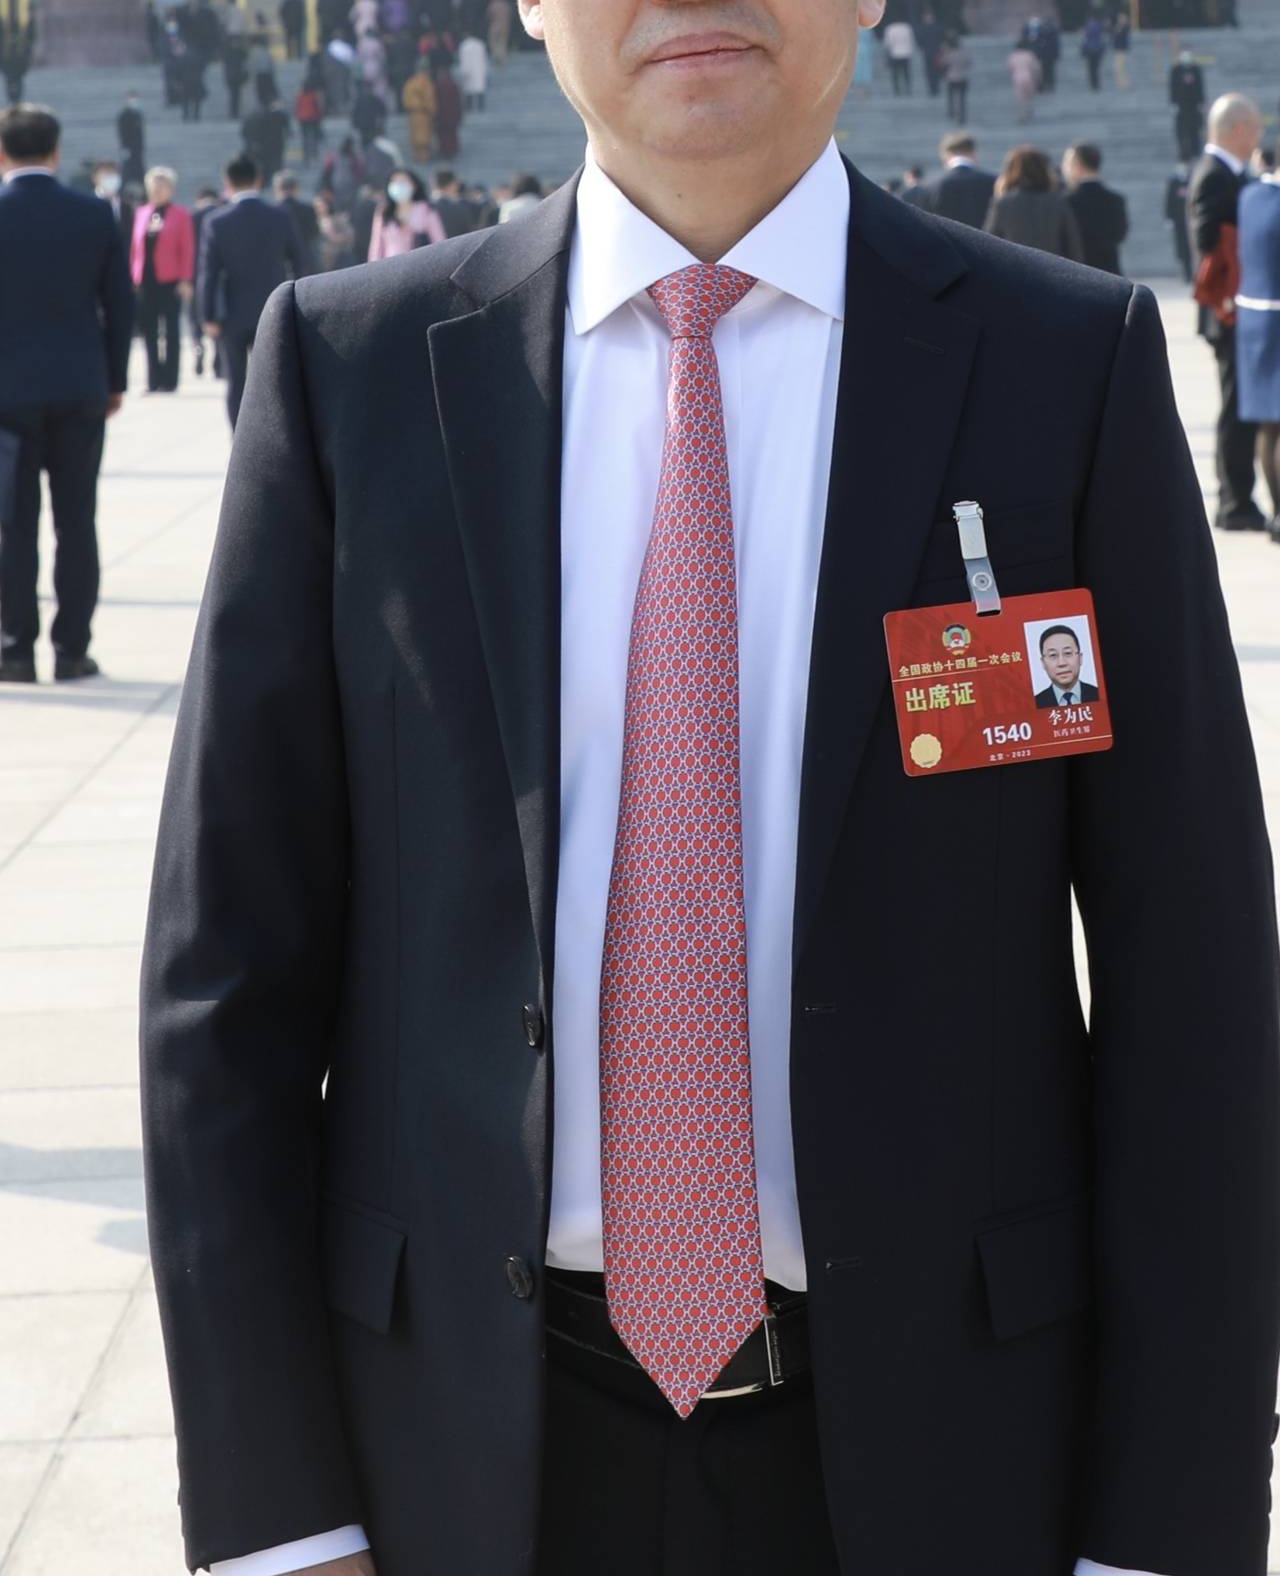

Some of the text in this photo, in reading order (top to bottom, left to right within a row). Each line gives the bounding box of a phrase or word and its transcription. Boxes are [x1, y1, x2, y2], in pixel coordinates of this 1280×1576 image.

[899, 651, 1023, 678] 全国政协十四届一次会议
[905, 682, 976, 712] 出席证
[1048, 706, 1094, 726] 李为民
[982, 722, 1033, 746] 1540
